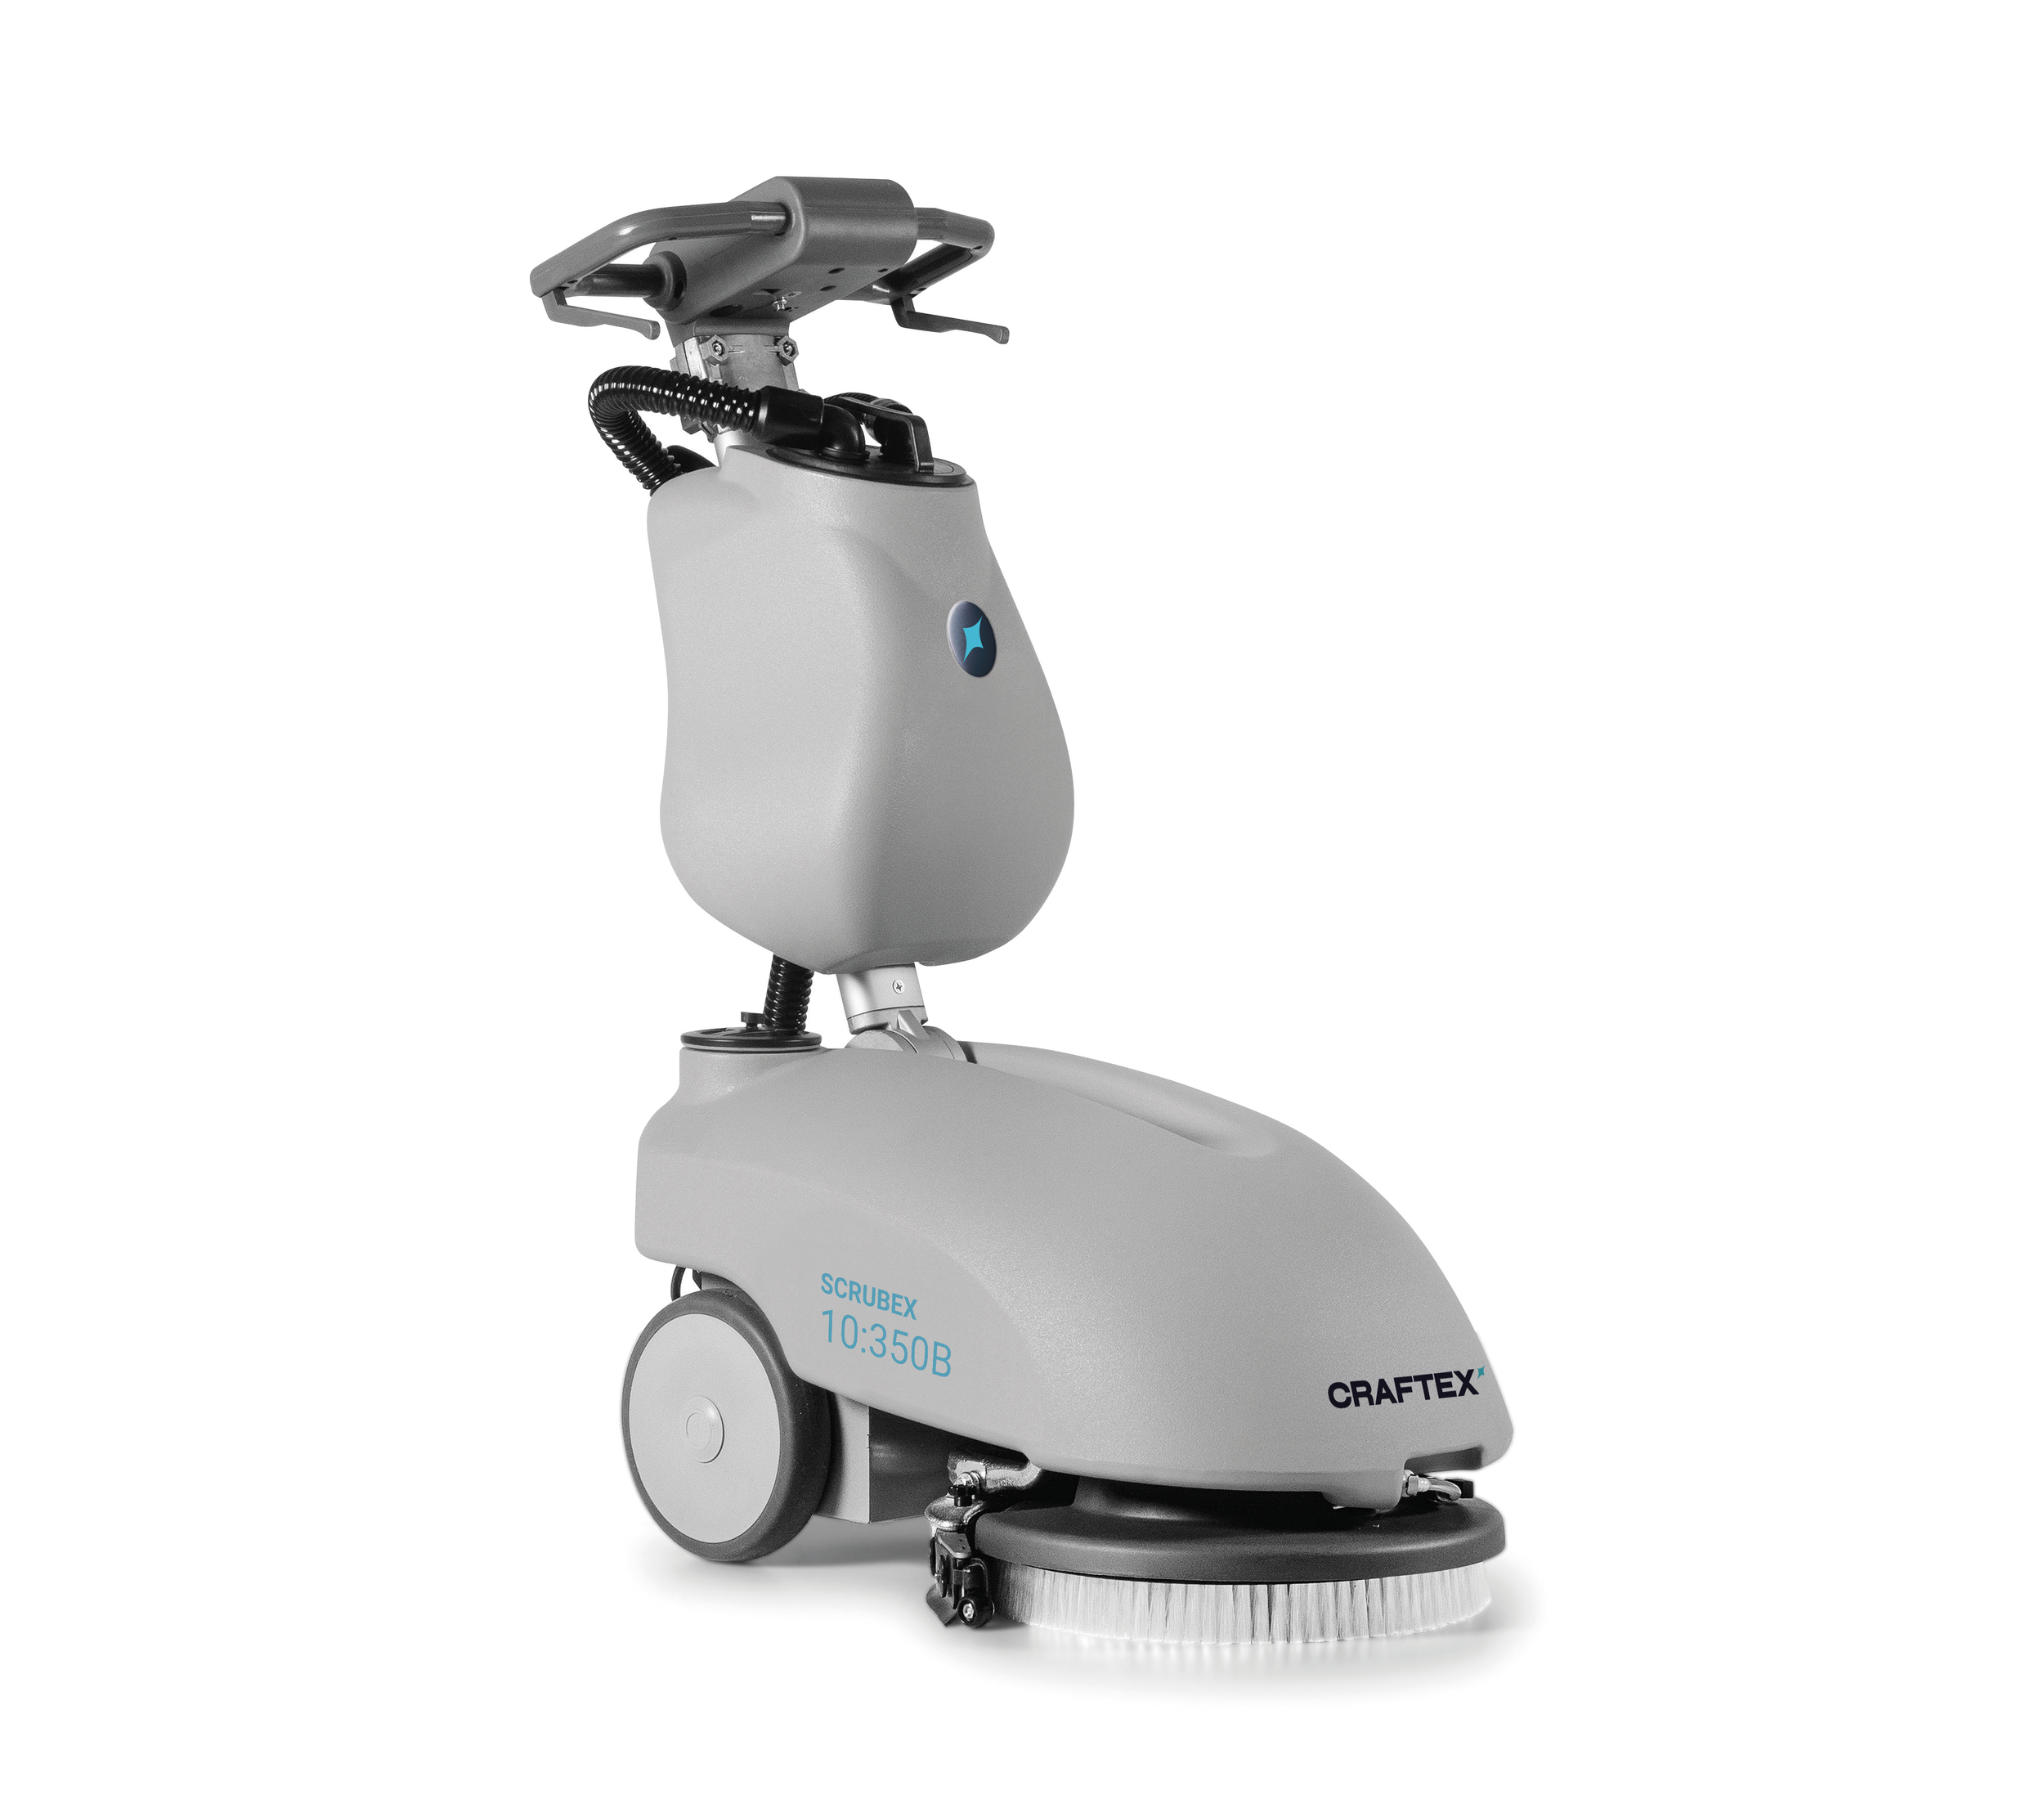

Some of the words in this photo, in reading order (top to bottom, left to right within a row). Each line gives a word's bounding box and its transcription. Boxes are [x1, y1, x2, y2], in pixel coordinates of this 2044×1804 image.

[820, 1272, 917, 1320] SCRUBEX
[822, 1309, 952, 1377] 10:350B
[1328, 1368, 1479, 1408] CRAFTEX
